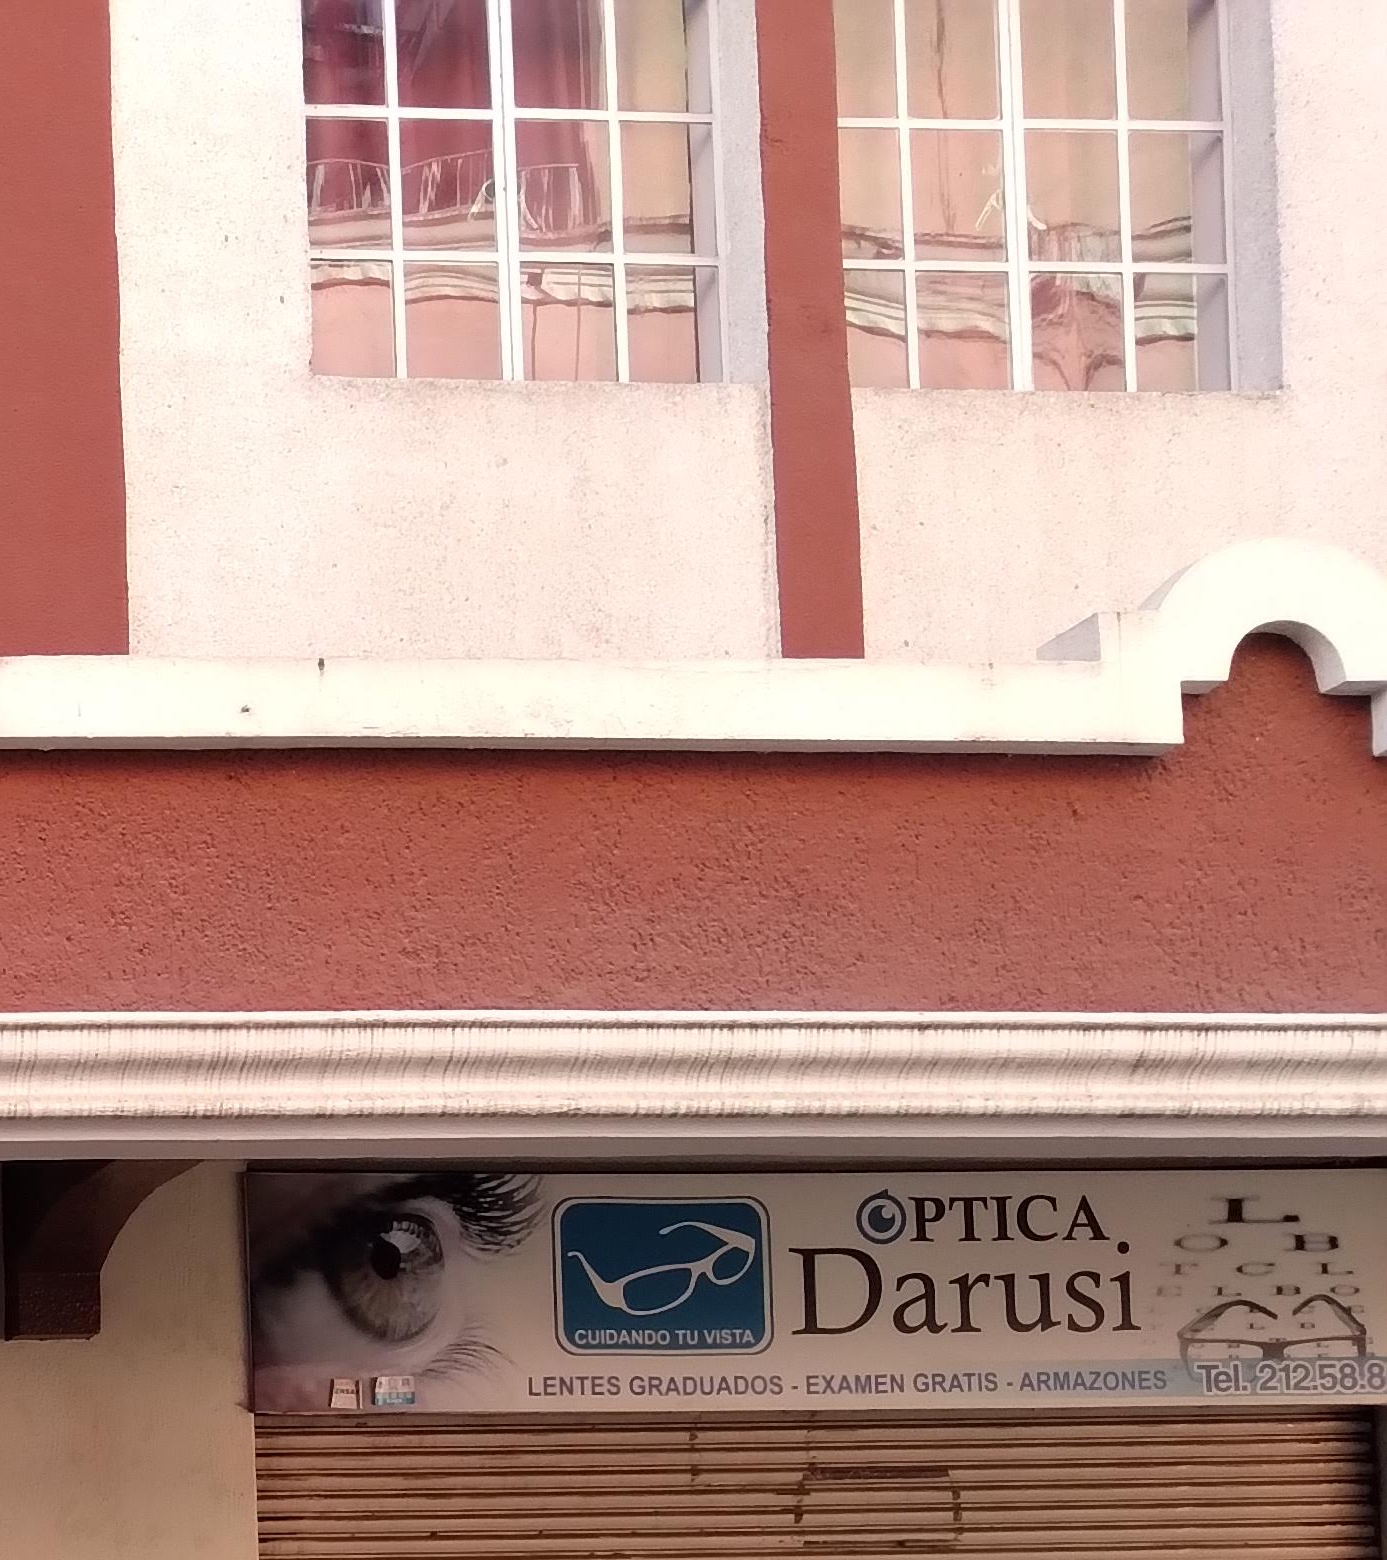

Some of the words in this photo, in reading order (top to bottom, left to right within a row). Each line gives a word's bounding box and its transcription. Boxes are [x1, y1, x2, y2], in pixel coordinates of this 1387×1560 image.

[789, 1241, 1142, 1335] Darusi
[574, 1328, 670, 1346] CUIDANDO
[676, 1328, 699, 1345] TU
[703, 1328, 755, 1345] VISTA
[527, 1375, 622, 1397] LENTES
[628, 1375, 784, 1396] GRADUADOS
[805, 1373, 905, 1395] EXAMEN
[912, 1372, 999, 1393] GRATIS
[1018, 1370, 1168, 1392] ARMAZONES
[1195, 1362, 1249, 1393] Tel.
